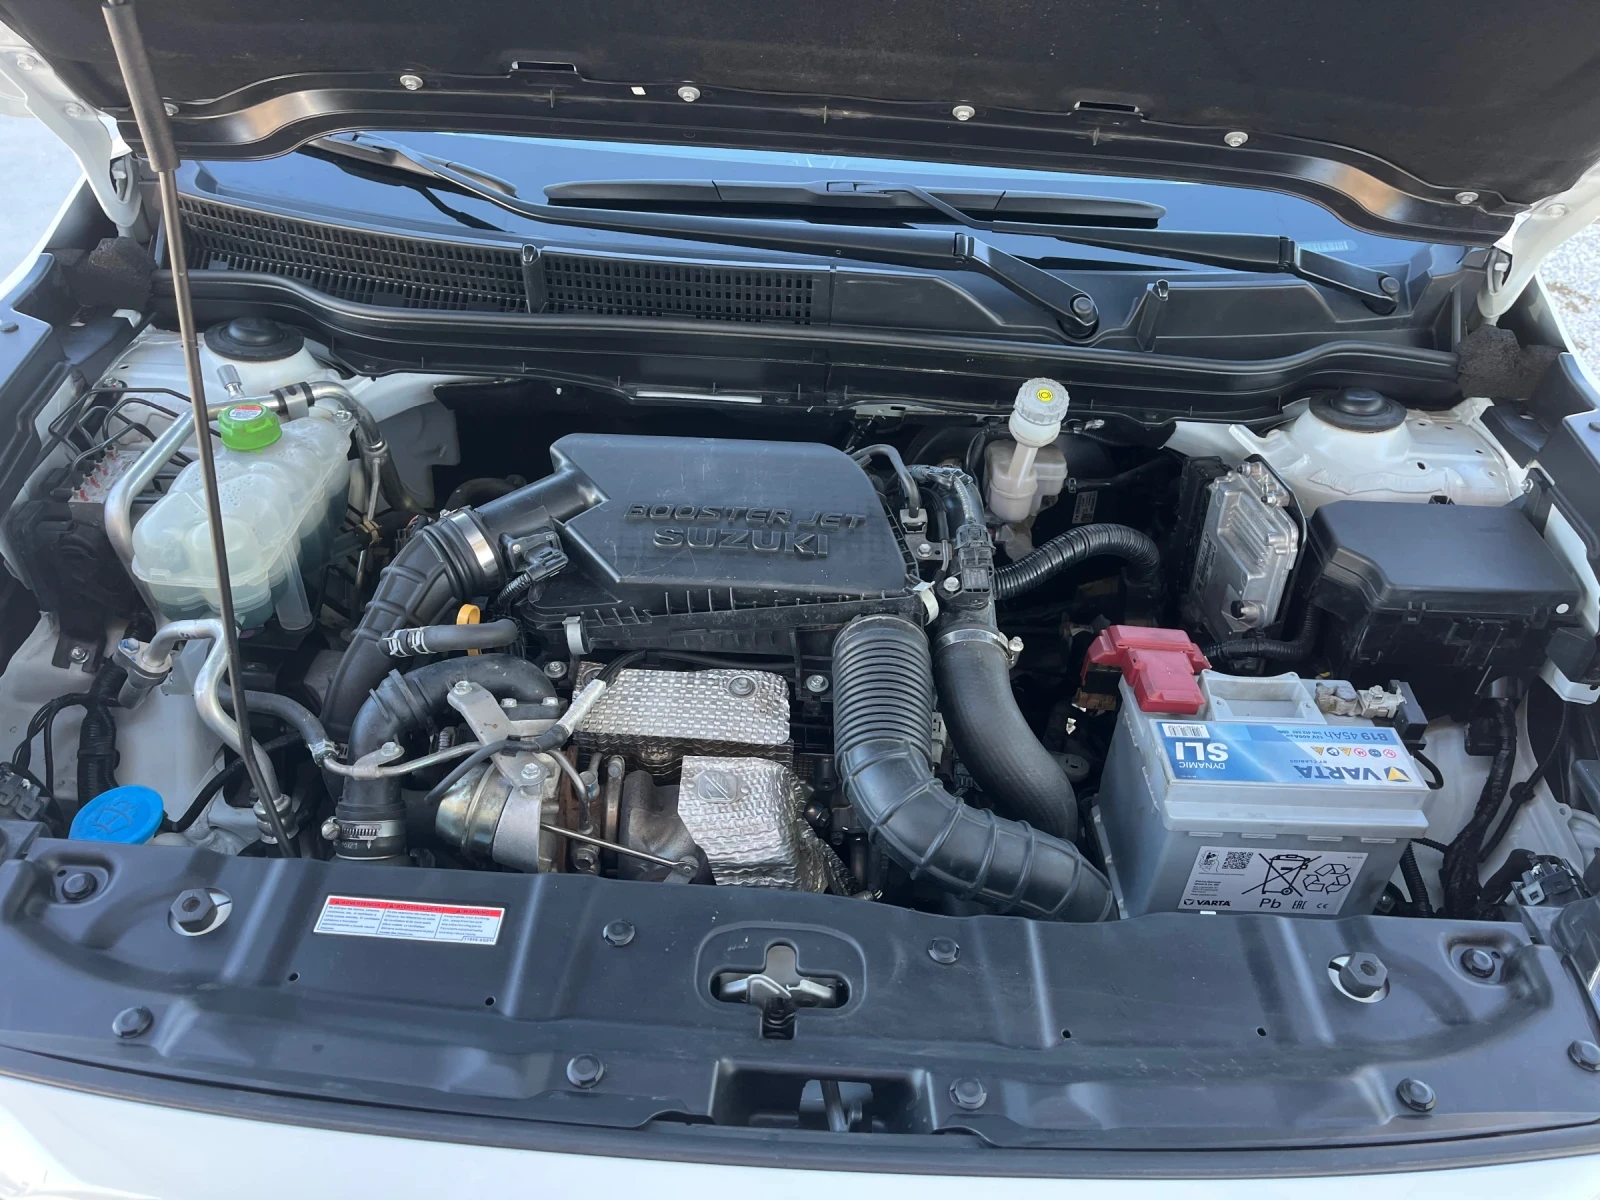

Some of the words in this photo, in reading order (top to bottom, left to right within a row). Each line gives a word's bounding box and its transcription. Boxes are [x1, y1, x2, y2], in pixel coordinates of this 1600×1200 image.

[623, 502, 793, 525] BOOSTER
[796, 509, 867, 530] JET
[652, 526, 829, 557] SUZUKI
[1323, 731, 1358, 740] 45Ah
[1361, 732, 1388, 742] B19
[1175, 741, 1229, 761] SLI
[1178, 760, 1226, 770] DYNAMIC
[1293, 765, 1382, 781] VARTA
[396, 904, 442, 912] AVERTISSEMENT
[1197, 899, 1231, 907] VARTA
[1259, 898, 1281, 909] Pb
